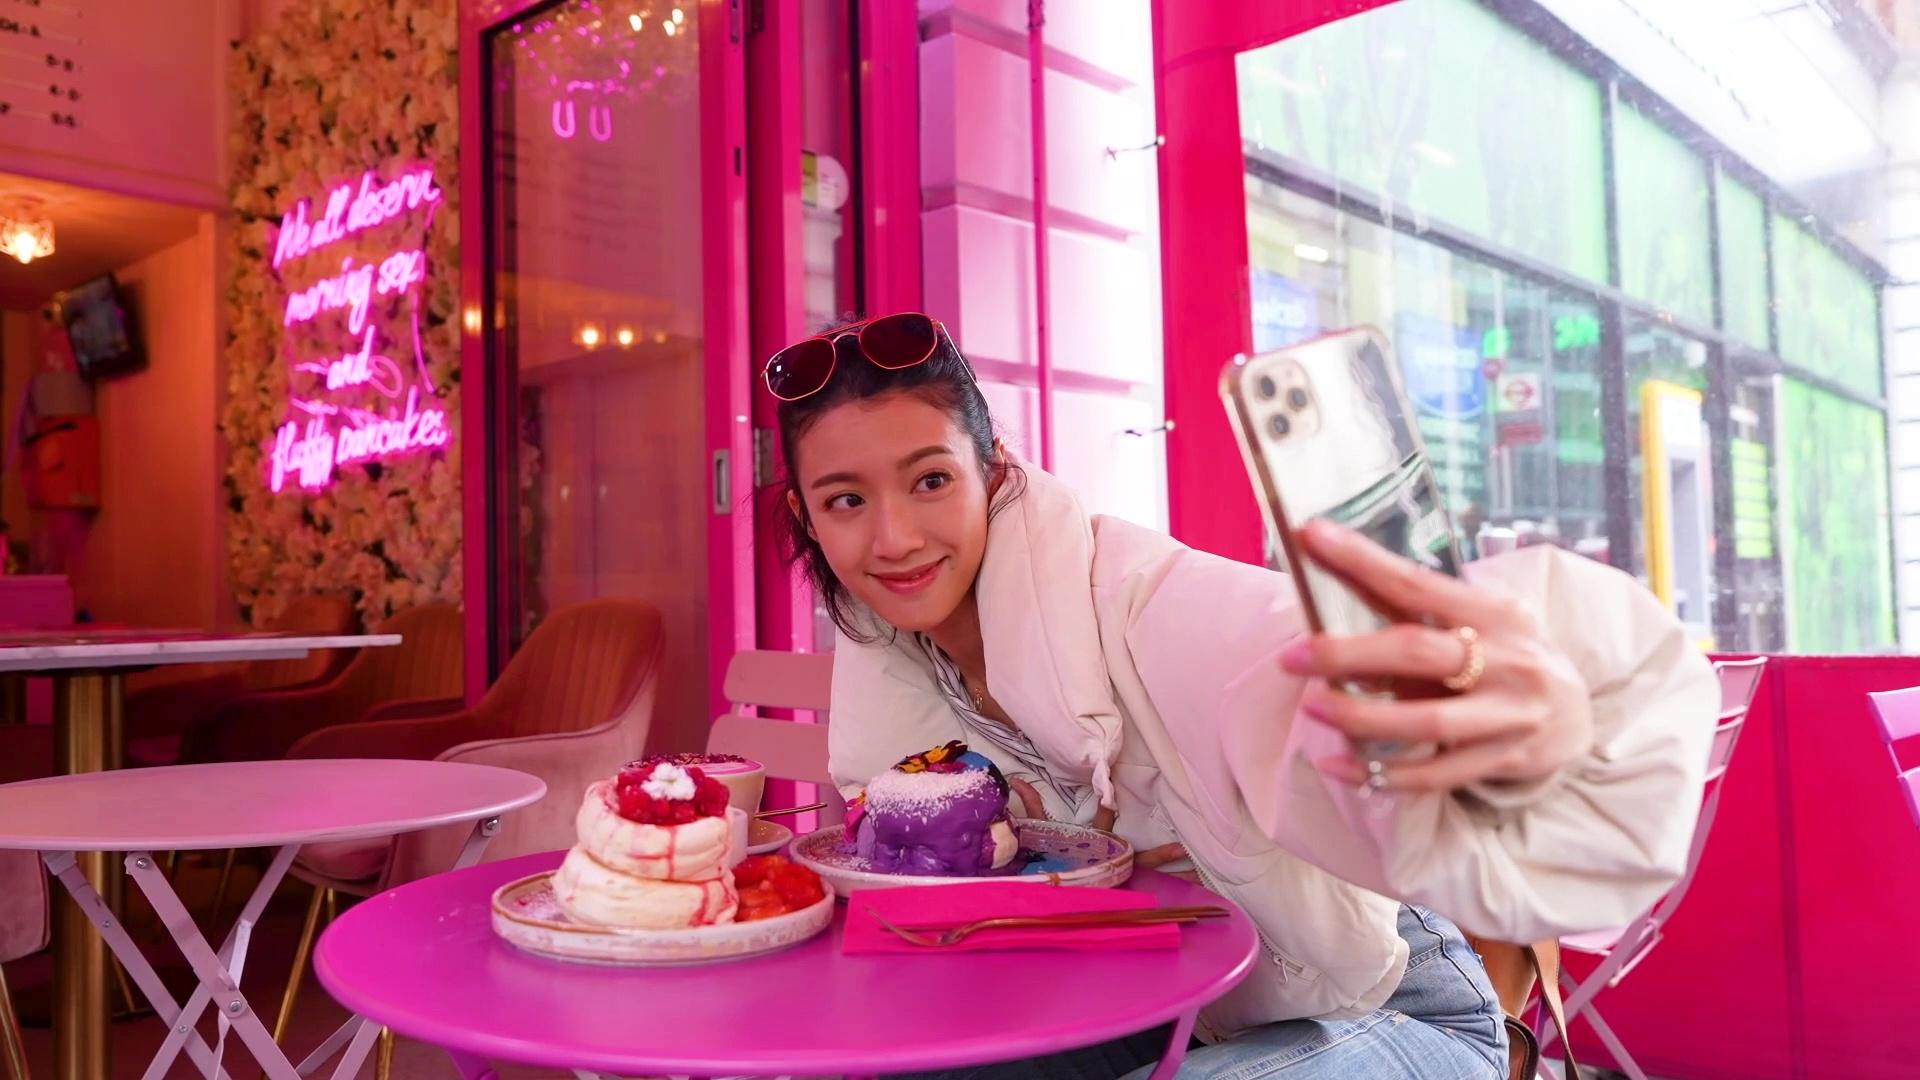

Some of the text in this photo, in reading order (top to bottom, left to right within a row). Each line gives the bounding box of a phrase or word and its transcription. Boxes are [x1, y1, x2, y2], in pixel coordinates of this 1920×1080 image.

[273, 200, 311, 268] We
[311, 184, 348, 248] all
[284, 250, 422, 335] morning sex
[326, 325, 376, 390] and
[271, 415, 334, 493] fluffy
